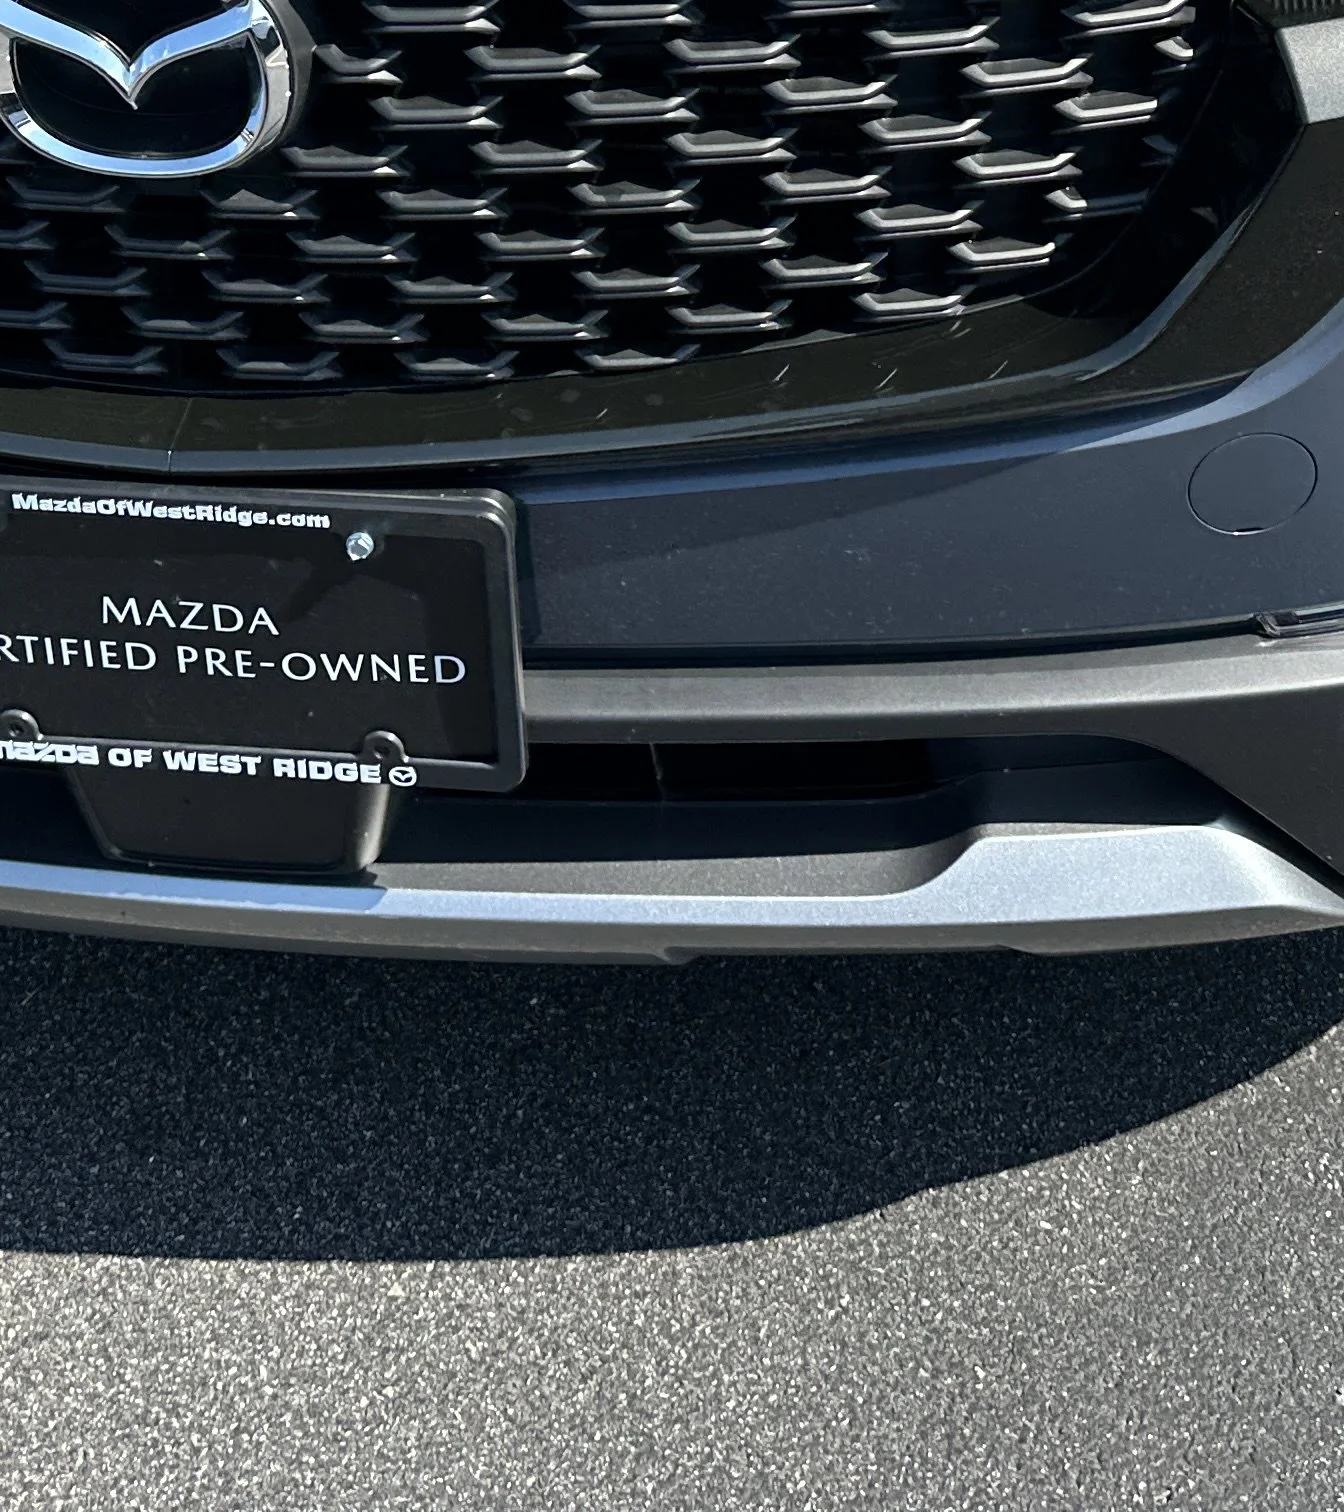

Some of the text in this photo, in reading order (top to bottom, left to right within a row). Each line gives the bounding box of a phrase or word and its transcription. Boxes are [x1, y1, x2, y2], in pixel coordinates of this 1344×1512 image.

[11, 491, 331, 529] MazdaOfWestRidge.com
[101, 595, 280, 637] MAZDA
[176, 645, 467, 685] PRE-OWNED
[108, 747, 154, 768] OF
[162, 749, 262, 776] WEST
[272, 757, 383, 786] RIDGE
